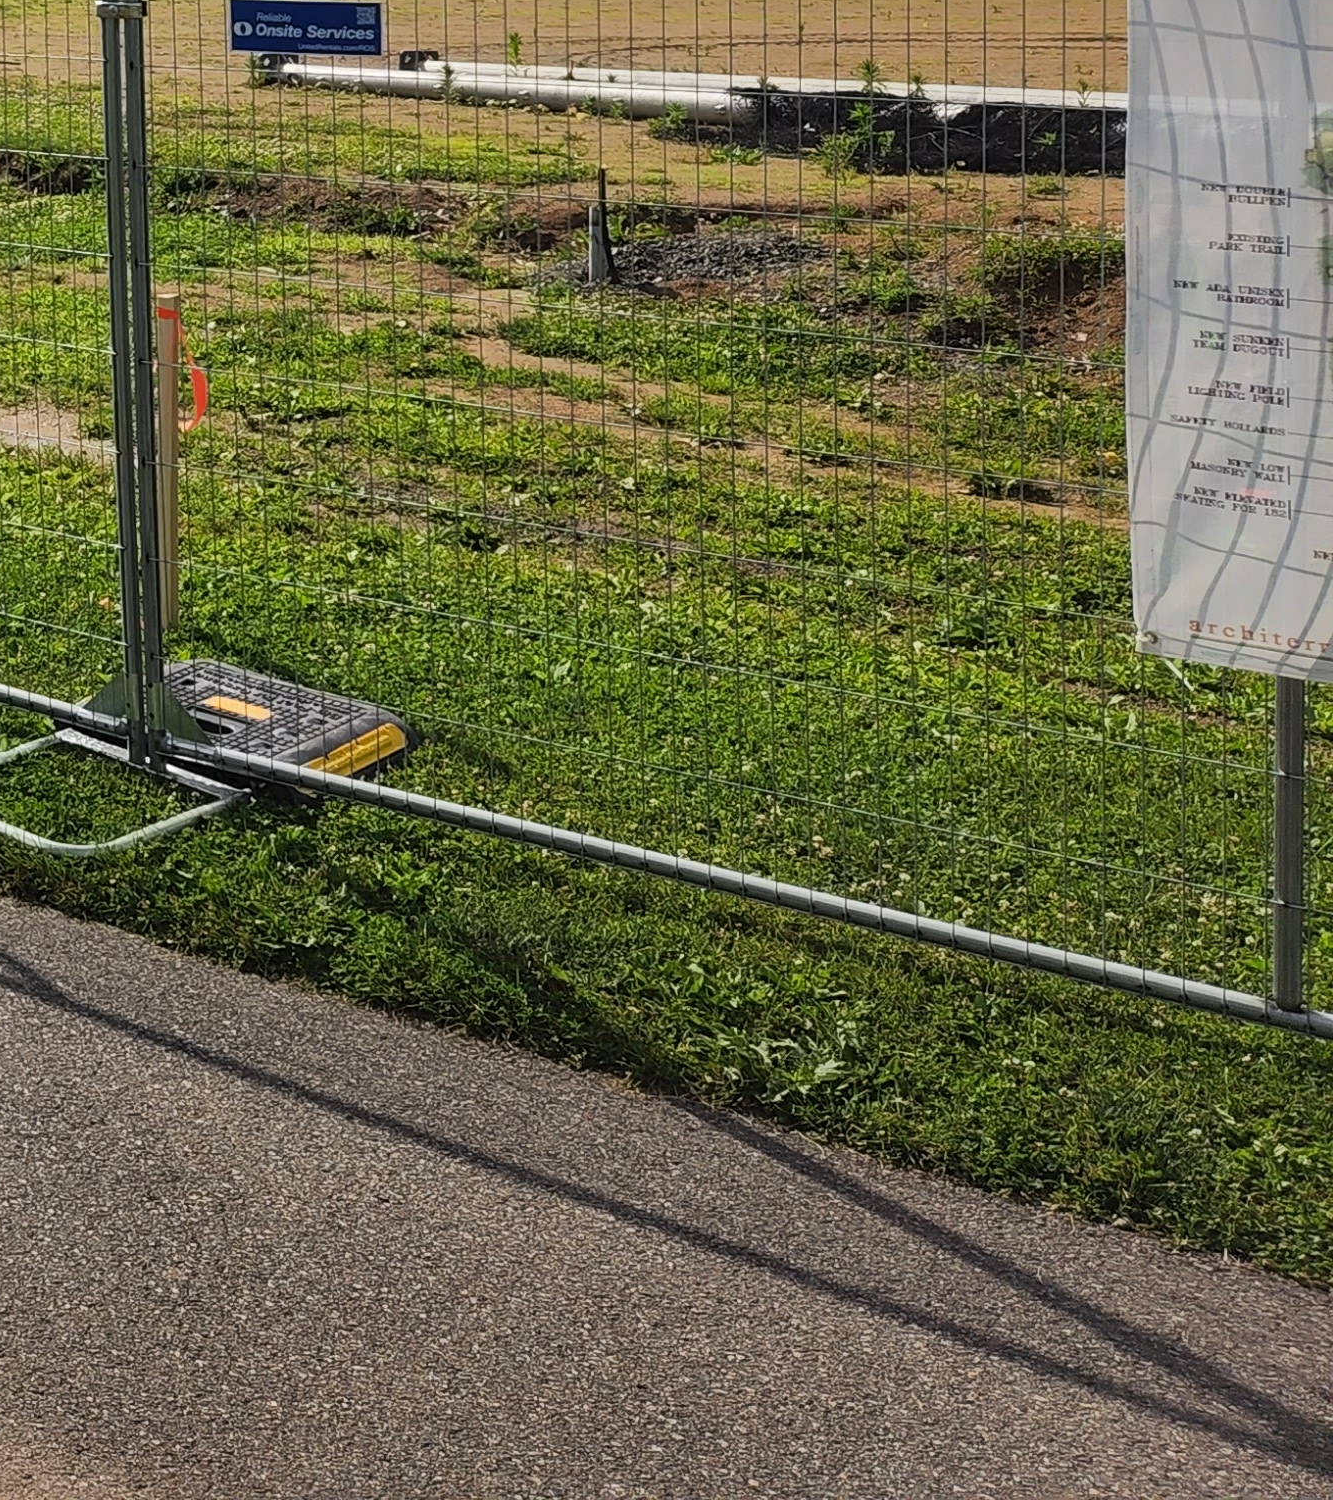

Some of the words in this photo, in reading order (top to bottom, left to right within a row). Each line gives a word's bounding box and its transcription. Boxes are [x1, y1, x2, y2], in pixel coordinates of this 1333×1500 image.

[256, 12, 292, 23] Reliable
[255, 23, 303, 38] Onsite
[306, 25, 375, 40] Services
[1201, 183, 1228, 192] NEW
[1236, 185, 1286, 196] DOUBLE
[1228, 195, 1286, 206] BULLPEN
[1227, 233, 1284, 244] EXISTING
[1208, 241, 1243, 251] PARK
[1250, 244, 1286, 255] TRAIL
[1173, 279, 1200, 288] NEW
[1206, 283, 1231, 293] ADA
[1238, 285, 1285, 297] UNISEX
[1217, 294, 1285, 307] BATHROOM
[1200, 330, 1226, 340] NEW
[1193, 339, 1226, 351] TEAM
[1233, 344, 1284, 357] DUGOUT
[1188, 386, 1245, 400] LIGHTING
[1252, 394, 1285, 406] POLE
[1215, 380, 1241, 390] NEW
[1249, 384, 1285, 396] FIELD
[1170, 415, 1217, 426] SAFETY
[1224, 421, 1286, 436] BOLLARDS
[1190, 461, 1247, 478] MASONRY
[1254, 471, 1285, 483] WALL
[1227, 458, 1253, 468] NEW
[1261, 464, 1285, 473] LOW
[1193, 486, 1219, 497] NEW
[1225, 492, 1286, 508] ELEVATED
[1175, 493, 1225, 509] SEATING
[1232, 504, 1257, 514] FOR
[1264, 509, 1287, 518] 182
